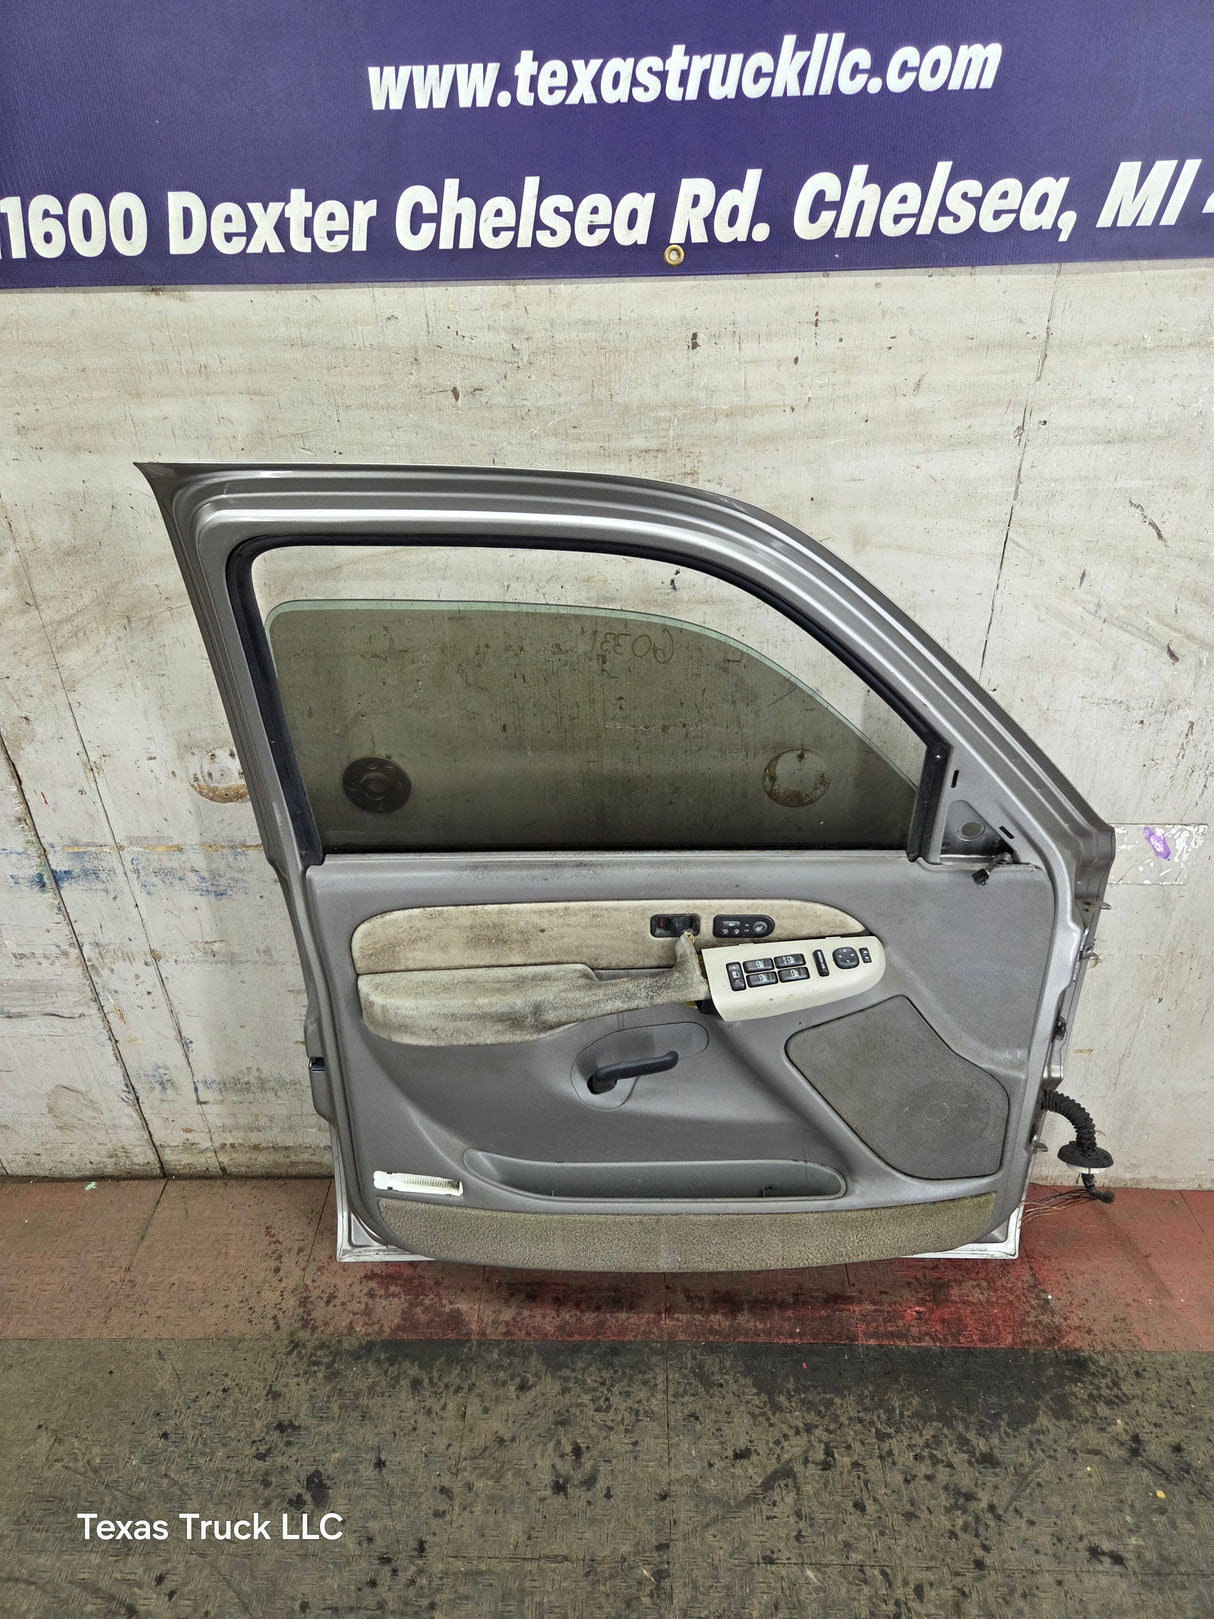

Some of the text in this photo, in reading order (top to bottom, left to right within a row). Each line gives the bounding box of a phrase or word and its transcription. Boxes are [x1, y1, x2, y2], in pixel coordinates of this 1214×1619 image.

[368, 33, 1002, 110] www.texastruckllc.com
[0, 159, 1202, 258] 1600 Dexter Chelsea Rd. Chelsea, MI
